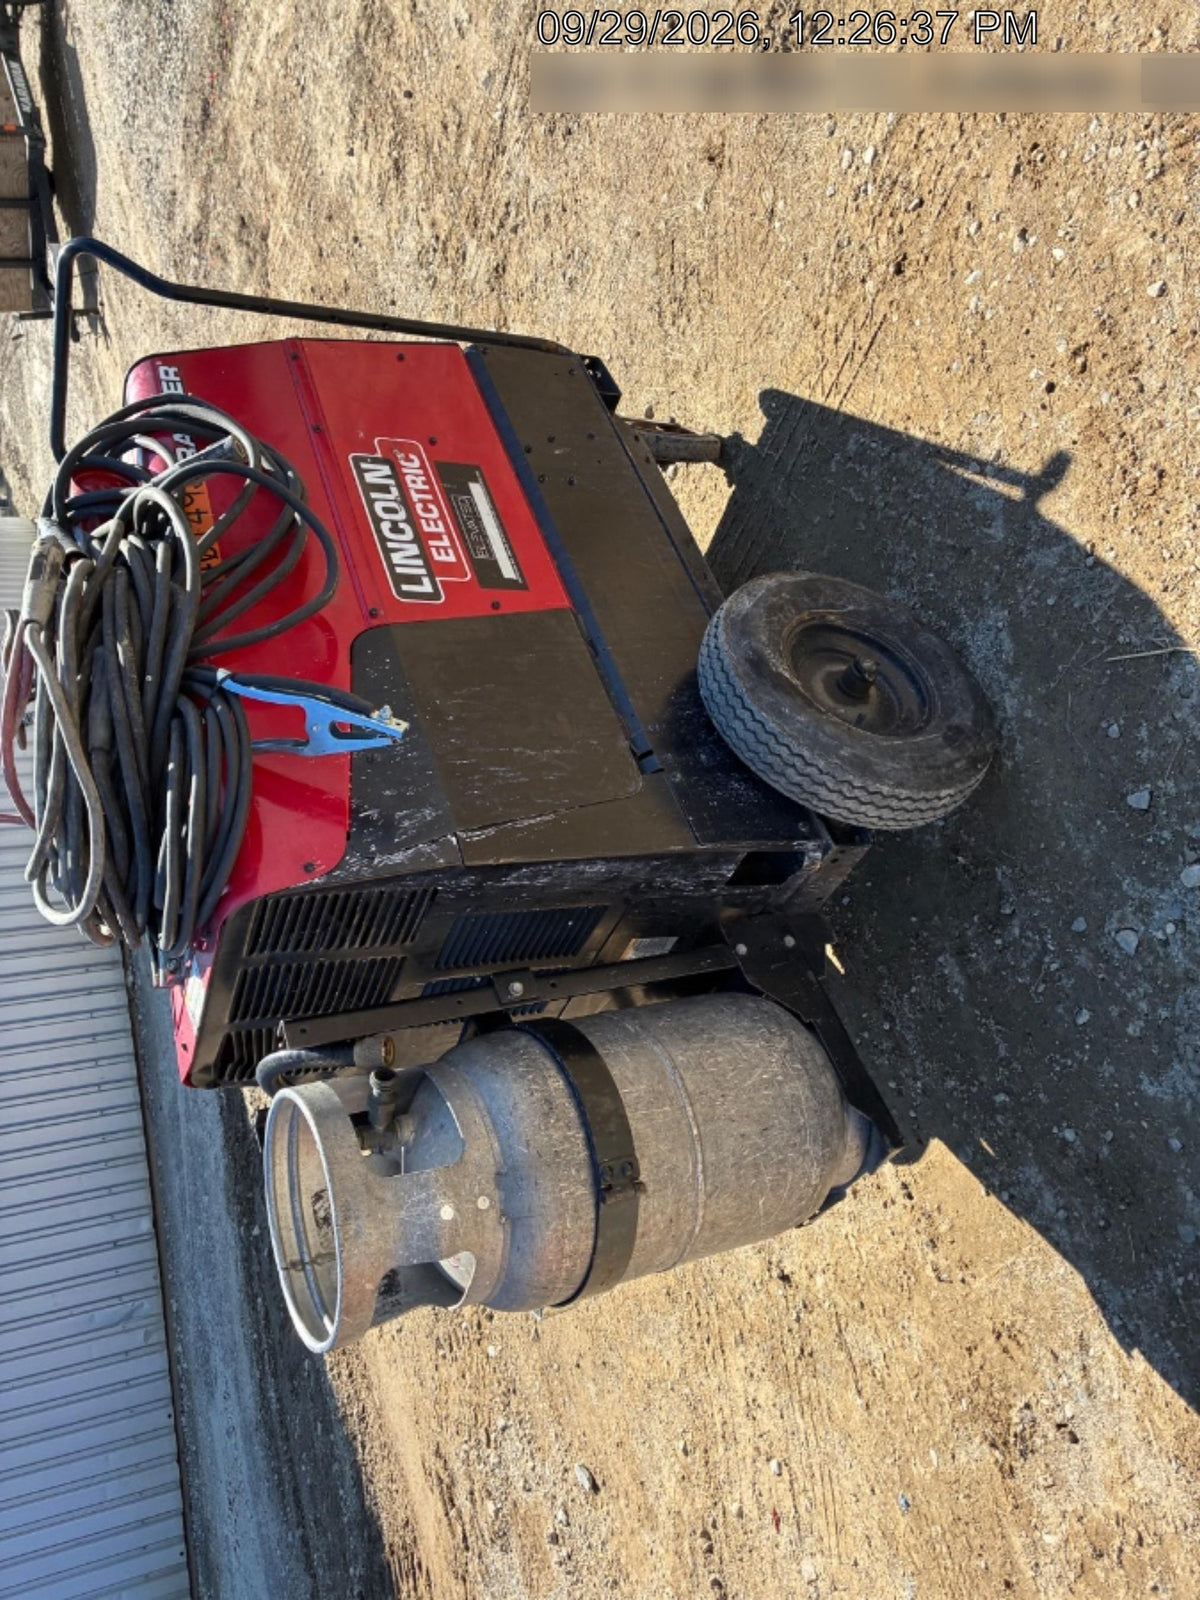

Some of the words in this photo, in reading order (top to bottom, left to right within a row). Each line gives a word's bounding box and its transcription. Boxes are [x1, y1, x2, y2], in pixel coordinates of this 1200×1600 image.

[158, 365, 197, 461] RAER
[360, 461, 434, 593] LINCOLN
[401, 453, 457, 563] ELECTRIC
